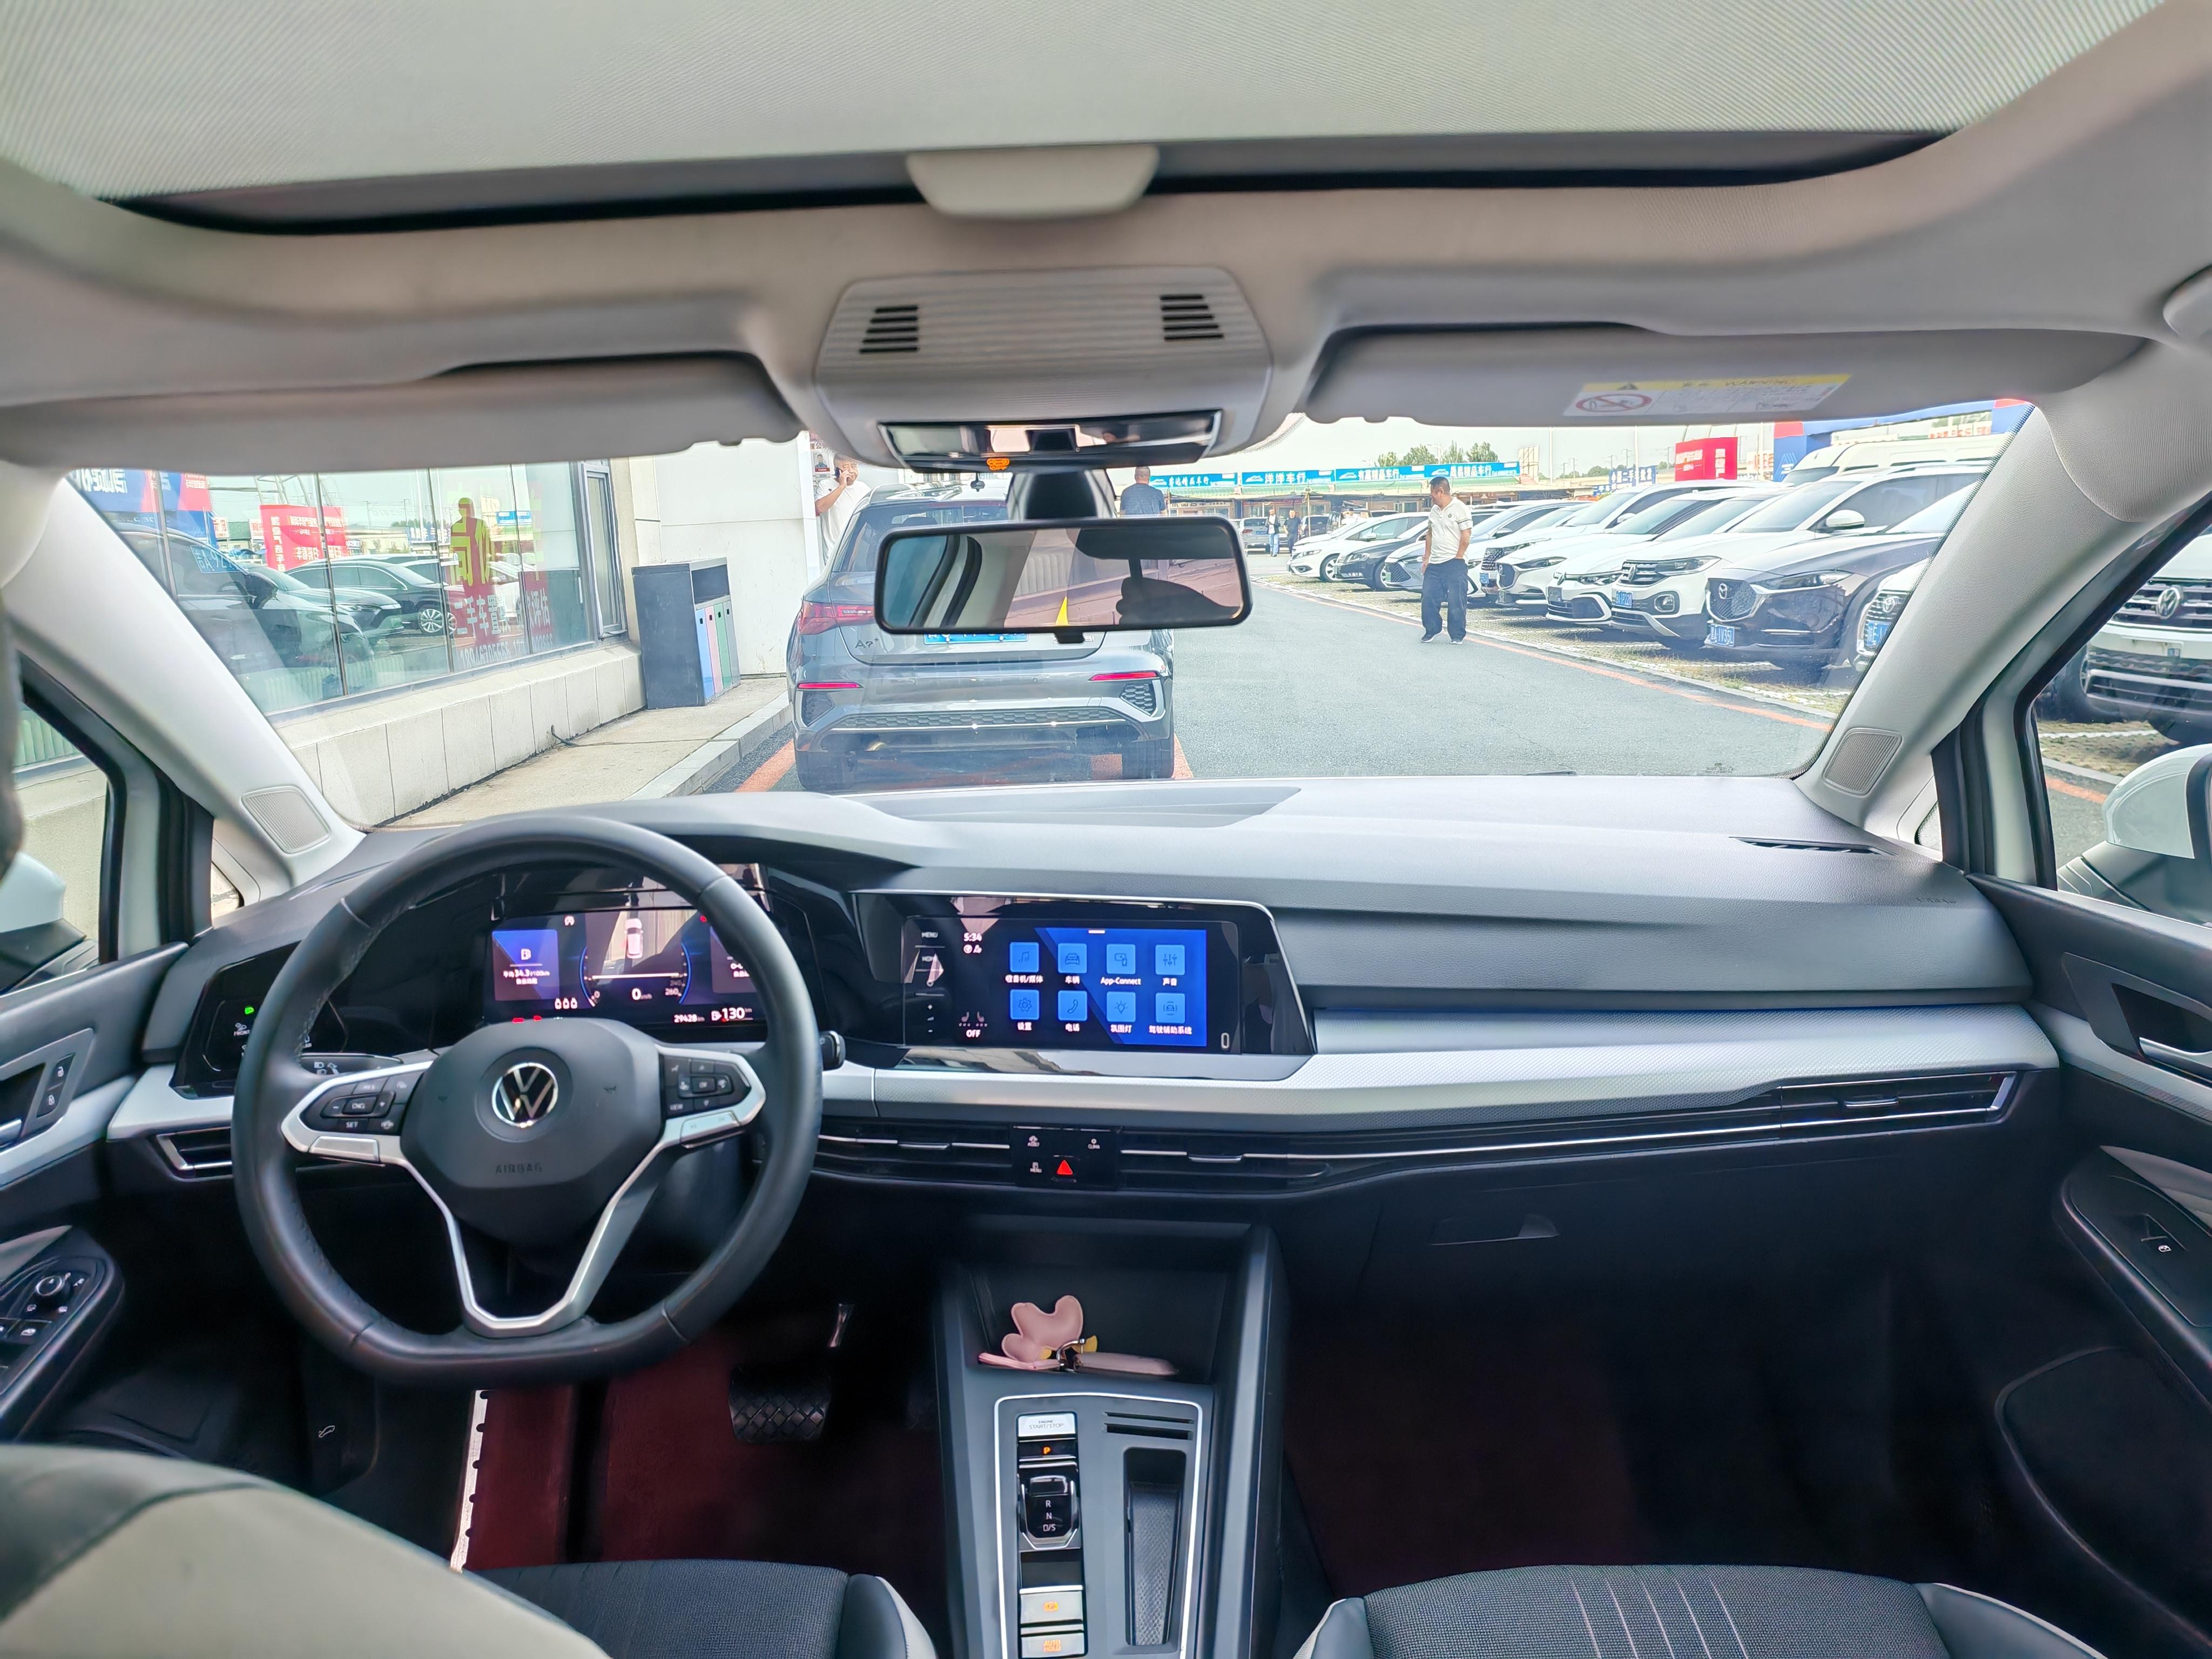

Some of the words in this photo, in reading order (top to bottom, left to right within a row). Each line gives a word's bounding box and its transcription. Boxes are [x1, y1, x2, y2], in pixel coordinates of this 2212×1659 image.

[1265, 471, 1306, 484] 洋洋车行
[1101, 976, 1141, 986] App-Connect
[631, 988, 642, 1001] 0
[721, 1007, 745, 1019] 130
[966, 1029, 981, 1038] OFF
[495, 1162, 542, 1174] AIRBAG
[1046, 1500, 1051, 1508] R
[1043, 1523, 1056, 1532] D/S
